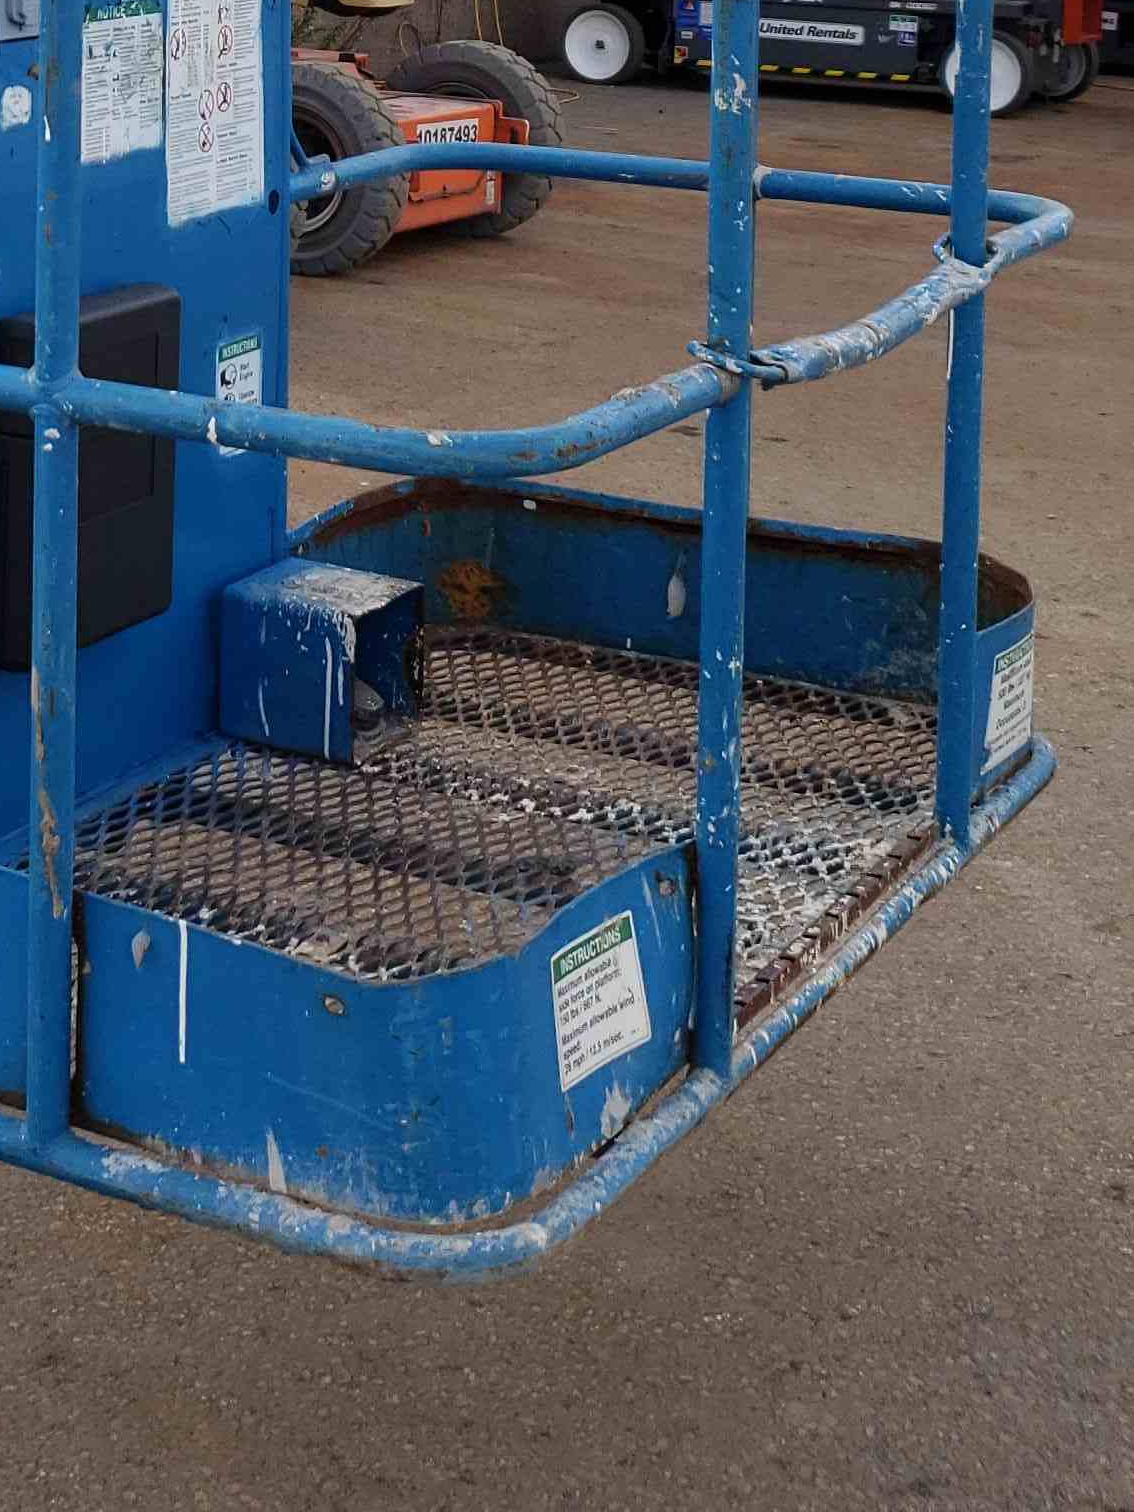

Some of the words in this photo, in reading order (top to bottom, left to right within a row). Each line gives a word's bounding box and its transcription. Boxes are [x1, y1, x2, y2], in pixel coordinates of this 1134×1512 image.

[760, 21, 804, 37] United
[806, 25, 859, 40] Rentals
[560, 927, 622, 976] INSTRUCTIONS
